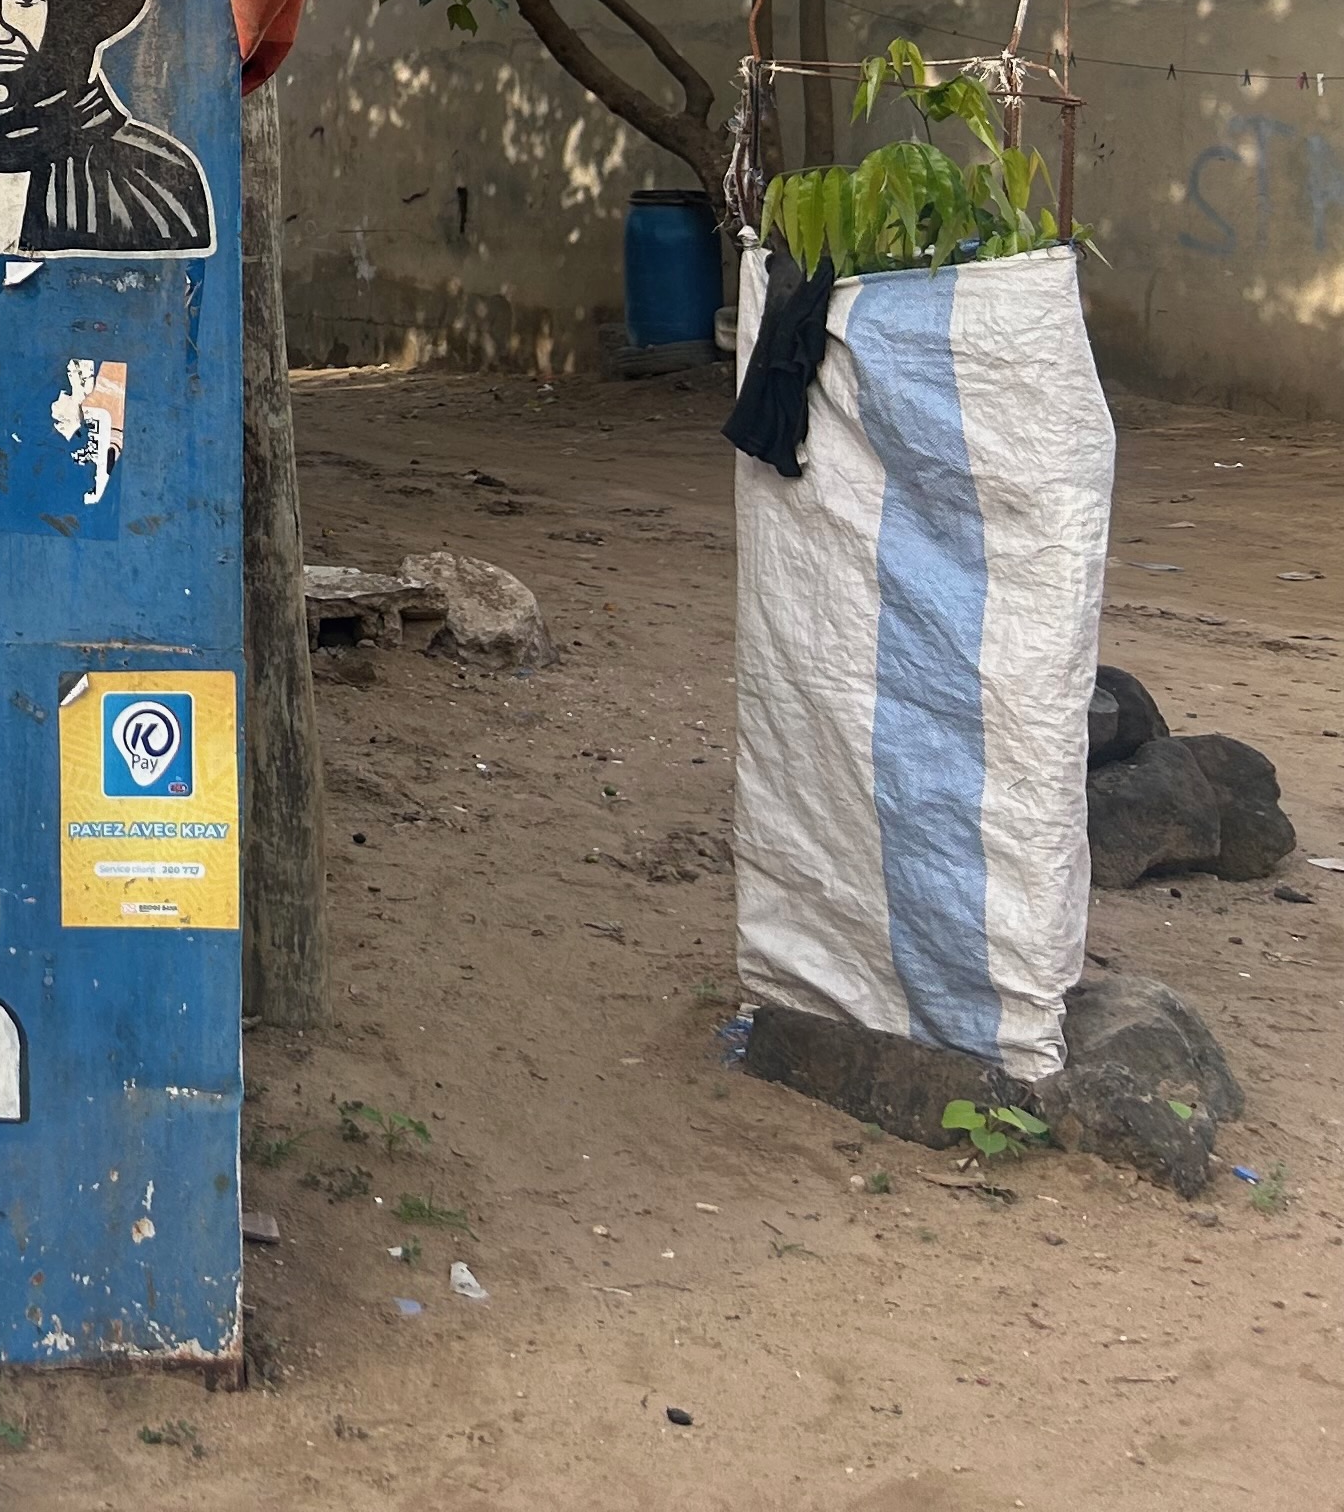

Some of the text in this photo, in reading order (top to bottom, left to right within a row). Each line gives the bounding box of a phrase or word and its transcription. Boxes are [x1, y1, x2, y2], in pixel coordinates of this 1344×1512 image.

[131, 753, 159, 774] Pay
[69, 822, 230, 839] PAYEZ AVEC KPAY
